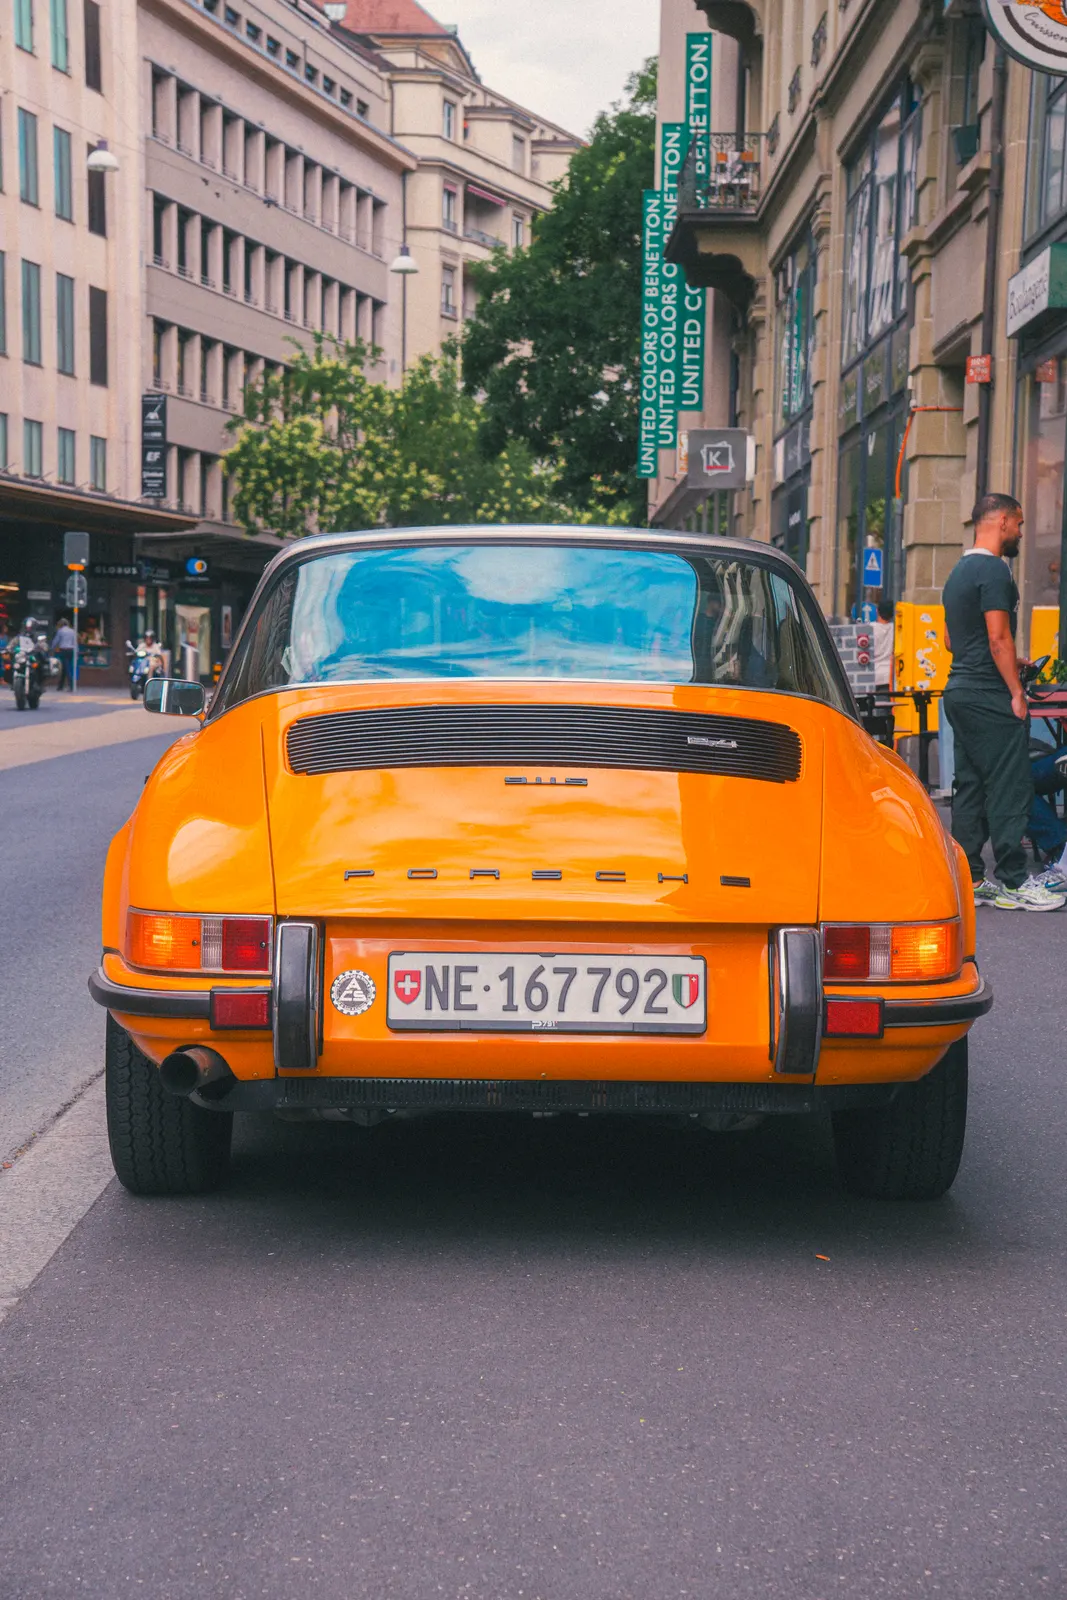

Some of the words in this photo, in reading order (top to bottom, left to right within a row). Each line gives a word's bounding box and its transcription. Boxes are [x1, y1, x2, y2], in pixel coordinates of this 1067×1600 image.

[662, 257, 678, 278] O
[644, 303, 659, 327] OF
[660, 283, 677, 363] COLORS
[642, 331, 658, 402] COLORS
[682, 319, 700, 405] UNITED
[641, 407, 656, 474] UNITED
[659, 369, 675, 444] UNITED
[344, 868, 751, 887] PORSCHE
